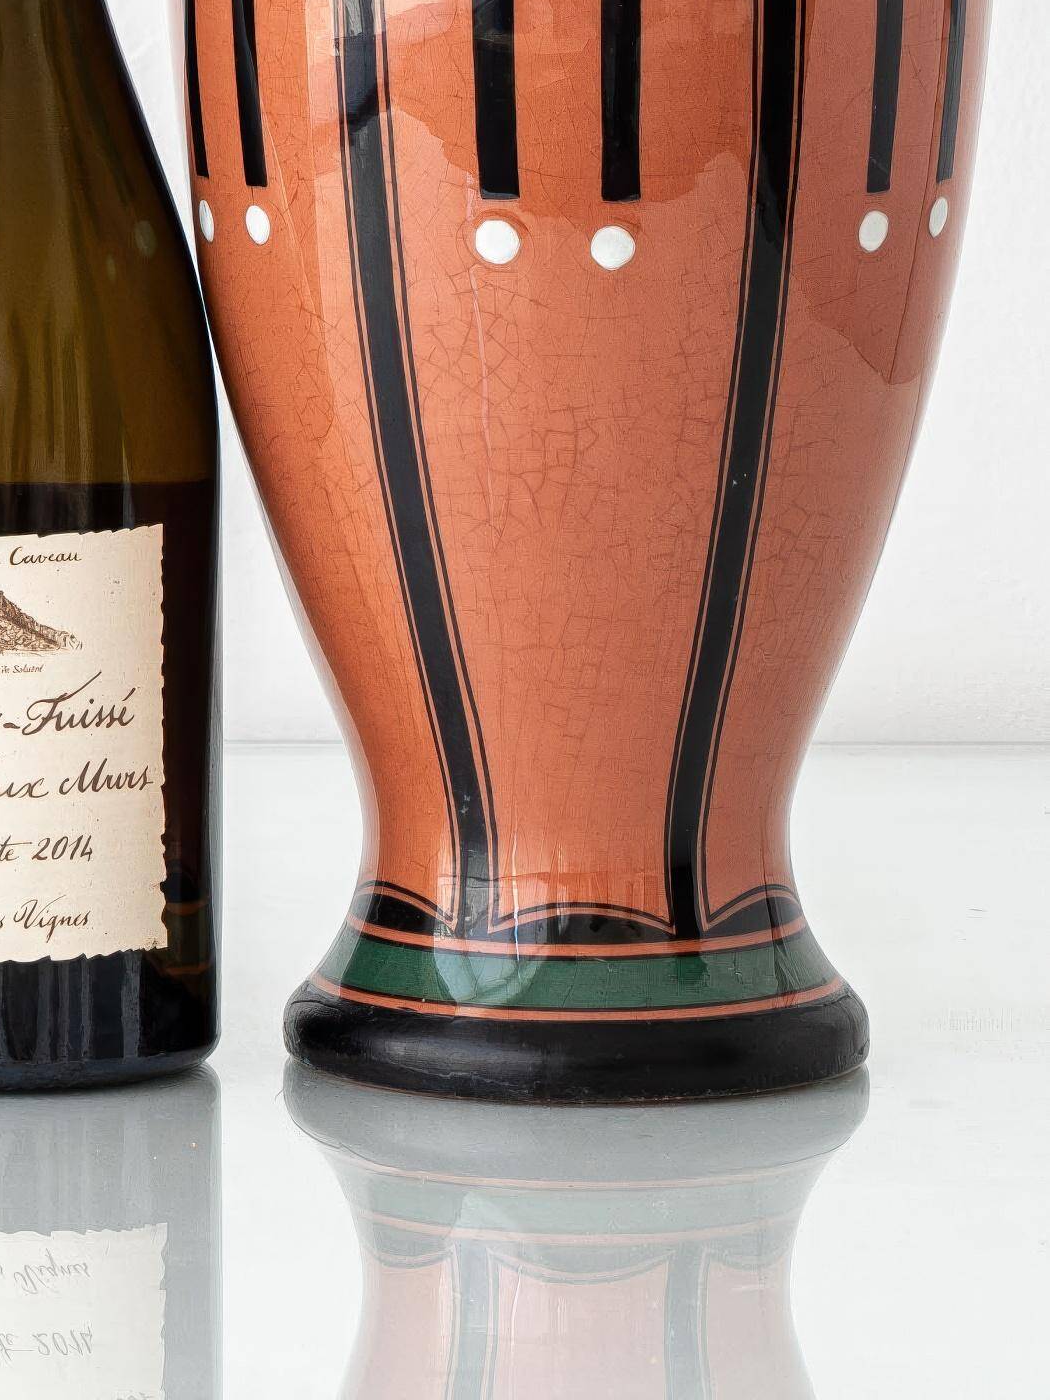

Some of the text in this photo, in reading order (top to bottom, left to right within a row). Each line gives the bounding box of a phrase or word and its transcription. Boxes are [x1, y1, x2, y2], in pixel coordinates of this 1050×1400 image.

[9, 546, 83, 567] Caveau
[59, 758, 154, 796] Murs
[34, 835, 93, 863] 2014
[13, 895, 91, 943] Vignes
